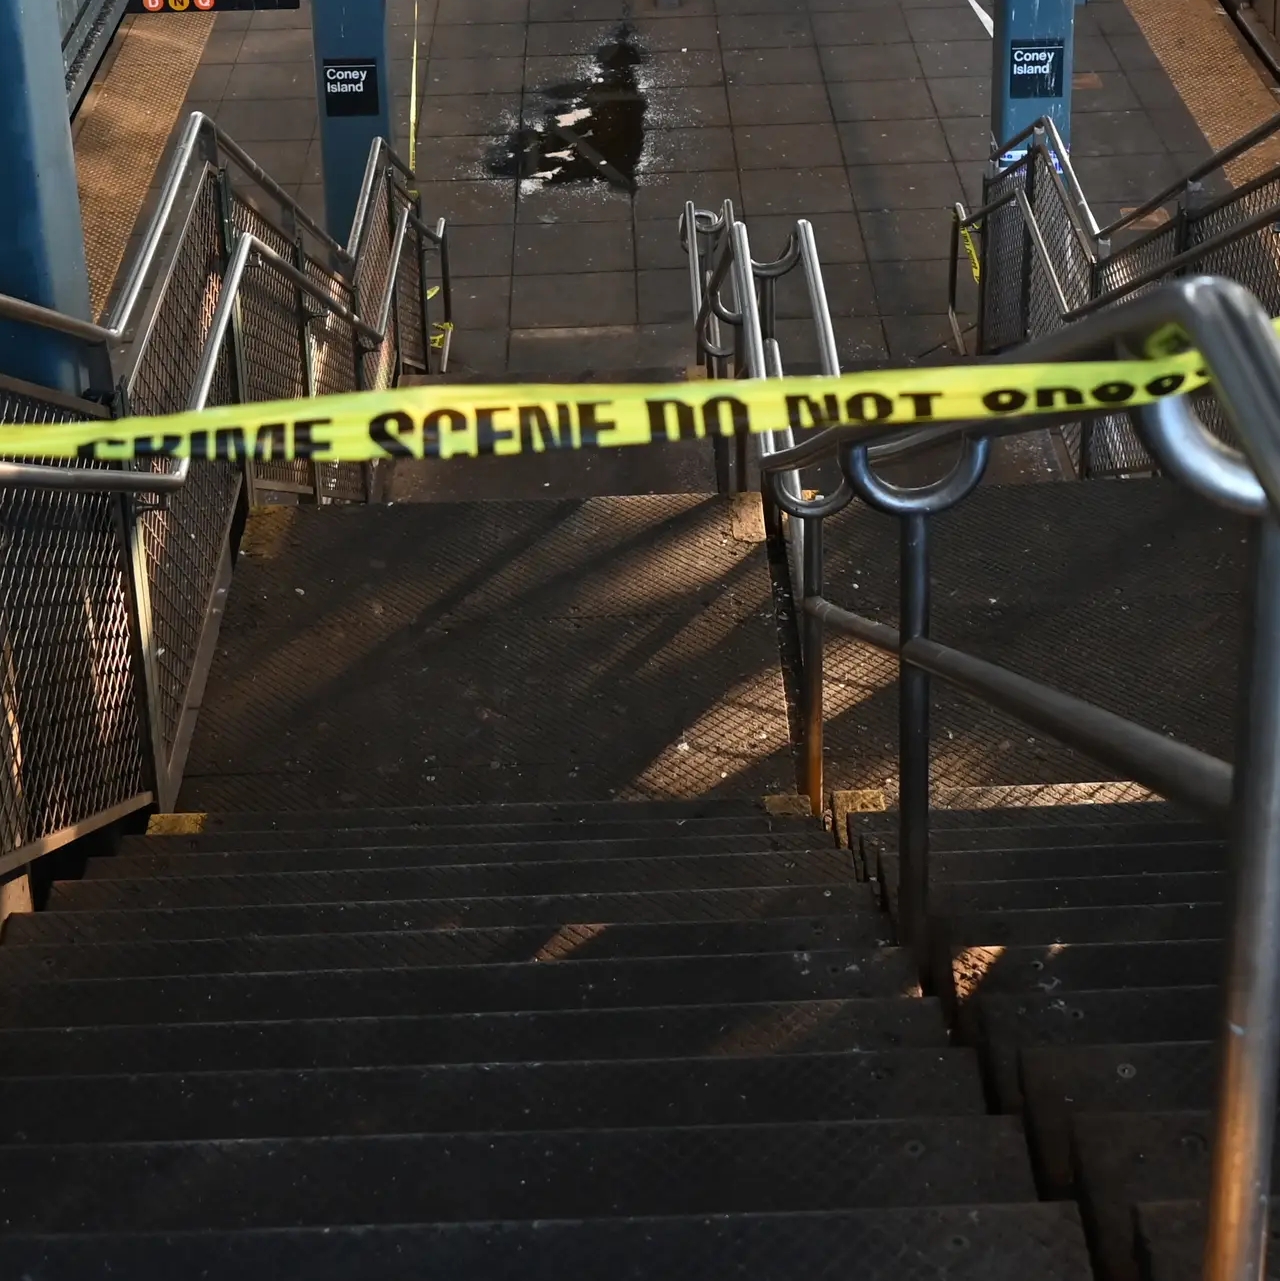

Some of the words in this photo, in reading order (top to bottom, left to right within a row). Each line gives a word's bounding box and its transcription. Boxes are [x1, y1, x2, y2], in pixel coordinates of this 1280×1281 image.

[1013, 50, 1054, 63] Coney
[1013, 63, 1050, 74] Island
[326, 69, 367, 81] Coney
[327, 81, 364, 92] Island
[368, 400, 618, 458] SCENE
[784, 390, 944, 428] NOT
